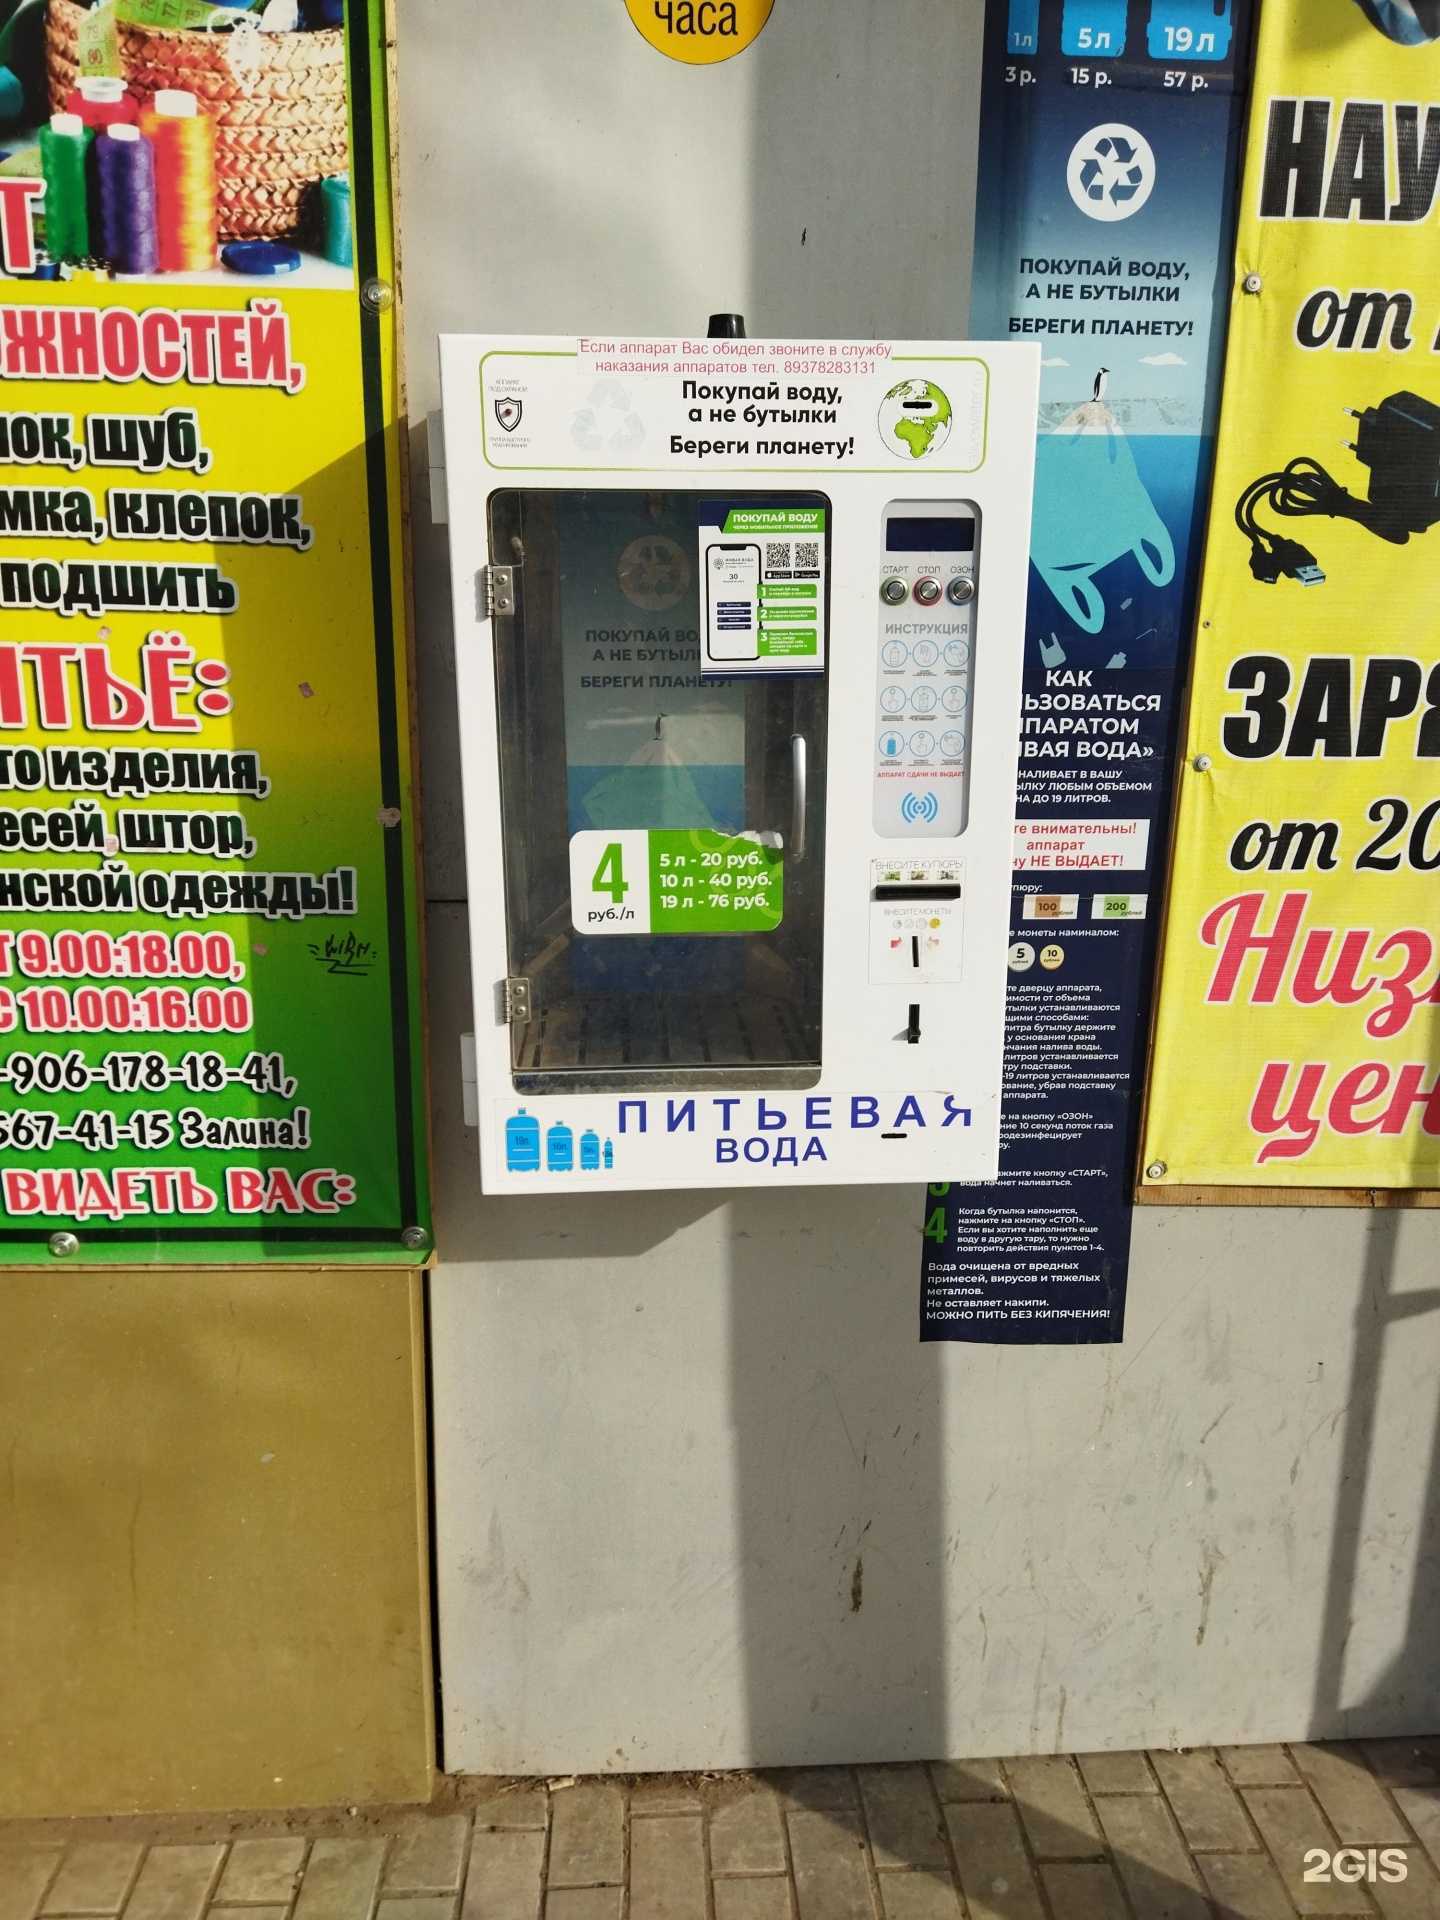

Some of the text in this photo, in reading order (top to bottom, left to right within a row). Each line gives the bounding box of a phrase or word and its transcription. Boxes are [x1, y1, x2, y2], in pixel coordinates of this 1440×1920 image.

[653, 1, 739, 36] часа
[1070, 67, 1112, 89] 15 р.
[1163, 71, 1209, 92] 57 р.
[1019, 256, 1190, 281] ПОКУПАЙ ВОДУ,
[1025, 283, 1180, 302] А НЕ БУТЫЛКИ
[1008, 317, 1194, 337] БЕРЕГИ ПЛАНЕТУ!
[580, 339, 892, 360] Если аппарат Вас обидел звоните в службу
[595, 360, 875, 377] наказания аппаратов тел. 89378283131
[682, 380, 843, 405] Покупай воду,
[688, 405, 837, 428] а не бутылки
[91, 411, 210, 471] шуб,
[670, 435, 855, 459] Береги планету!
[112, 492, 312, 547] клепок,
[733, 512, 818, 523] ПОКУПАЙ ВОДУ
[882, 565, 909, 574] СТАРТ
[917, 565, 941, 574] СТОП
[0, 561, 236, 613] подшить
[885, 624, 969, 635] ИНСТРУКЦИЯ
[610, 650, 632, 662] НЕ
[1045, 670, 1094, 687] КАК
[1076, 741, 1155, 760] ВОДА»
[49, 748, 269, 797] изделия,
[1018, 770, 1123, 779] НАЛИВАЕТ В ВАШУ
[1048, 783, 1153, 791] ЛЮБЫМ ОБЪЕМОМ
[1033, 795, 1050, 804] ДО
[1052, 795, 1063, 803] 19
[1064, 795, 1112, 803] ЛИТРОВ.
[122, 811, 255, 858] штор,
[1031, 822, 1137, 835] внимательны!
[1026, 840, 1085, 852] аппарат
[1228, 818, 1338, 872] от
[660, 853, 670, 867] 5
[674, 857, 686, 867] л
[701, 853, 723, 867] 20
[727, 851, 763, 870] руб.
[1030, 855, 1124, 868] НЕ ВЫДАЕТ!
[591, 842, 629, 904] 4
[659, 875, 678, 888] 10
[682, 877, 694, 888] л
[709, 874, 732, 887] 40
[736, 871, 773, 890] руб.
[141, 867, 357, 918] одежды!
[659, 896, 678, 909] 19
[682, 898, 694, 909] л
[708, 895, 730, 908] 76
[734, 893, 770, 911] руб.
[587, 908, 635, 923] руб./л
[1037, 903, 1057, 911] 100
[1106, 903, 1127, 911] 200
[20, 932, 245, 981] 9.00:18.00,
[1016, 948, 1025, 958] 5
[19, 987, 252, 1032] 10.00:16.00
[180, 1107, 312, 1149] Залина!
[715, 1136, 829, 1167] ВОДА
[1033, 1170, 1067, 1178] кнопку
[5, 1169, 356, 1219] ВИДЕТЬ ВАС:
[958, 1208, 985, 1216] Когда
[987, 1207, 1025, 1216] бутылка
[924, 1207, 948, 1244] 4
[1014, 1217, 1047, 1226] кнопку
[929, 1262, 1079, 1273] Вода очищена от вредных
[927, 1274, 988, 1285] примесей,
[991, 1276, 1038, 1284] вирусов
[1051, 1274, 1101, 1283] тяжелых
[927, 1287, 984, 1296] металлов.
[926, 1299, 1050, 1308] Не оставляет накипи.
[926, 1309, 1111, 1320] МОЖНО ПИТЬ БЕЗ КИПЯЧЕНИЯ!
